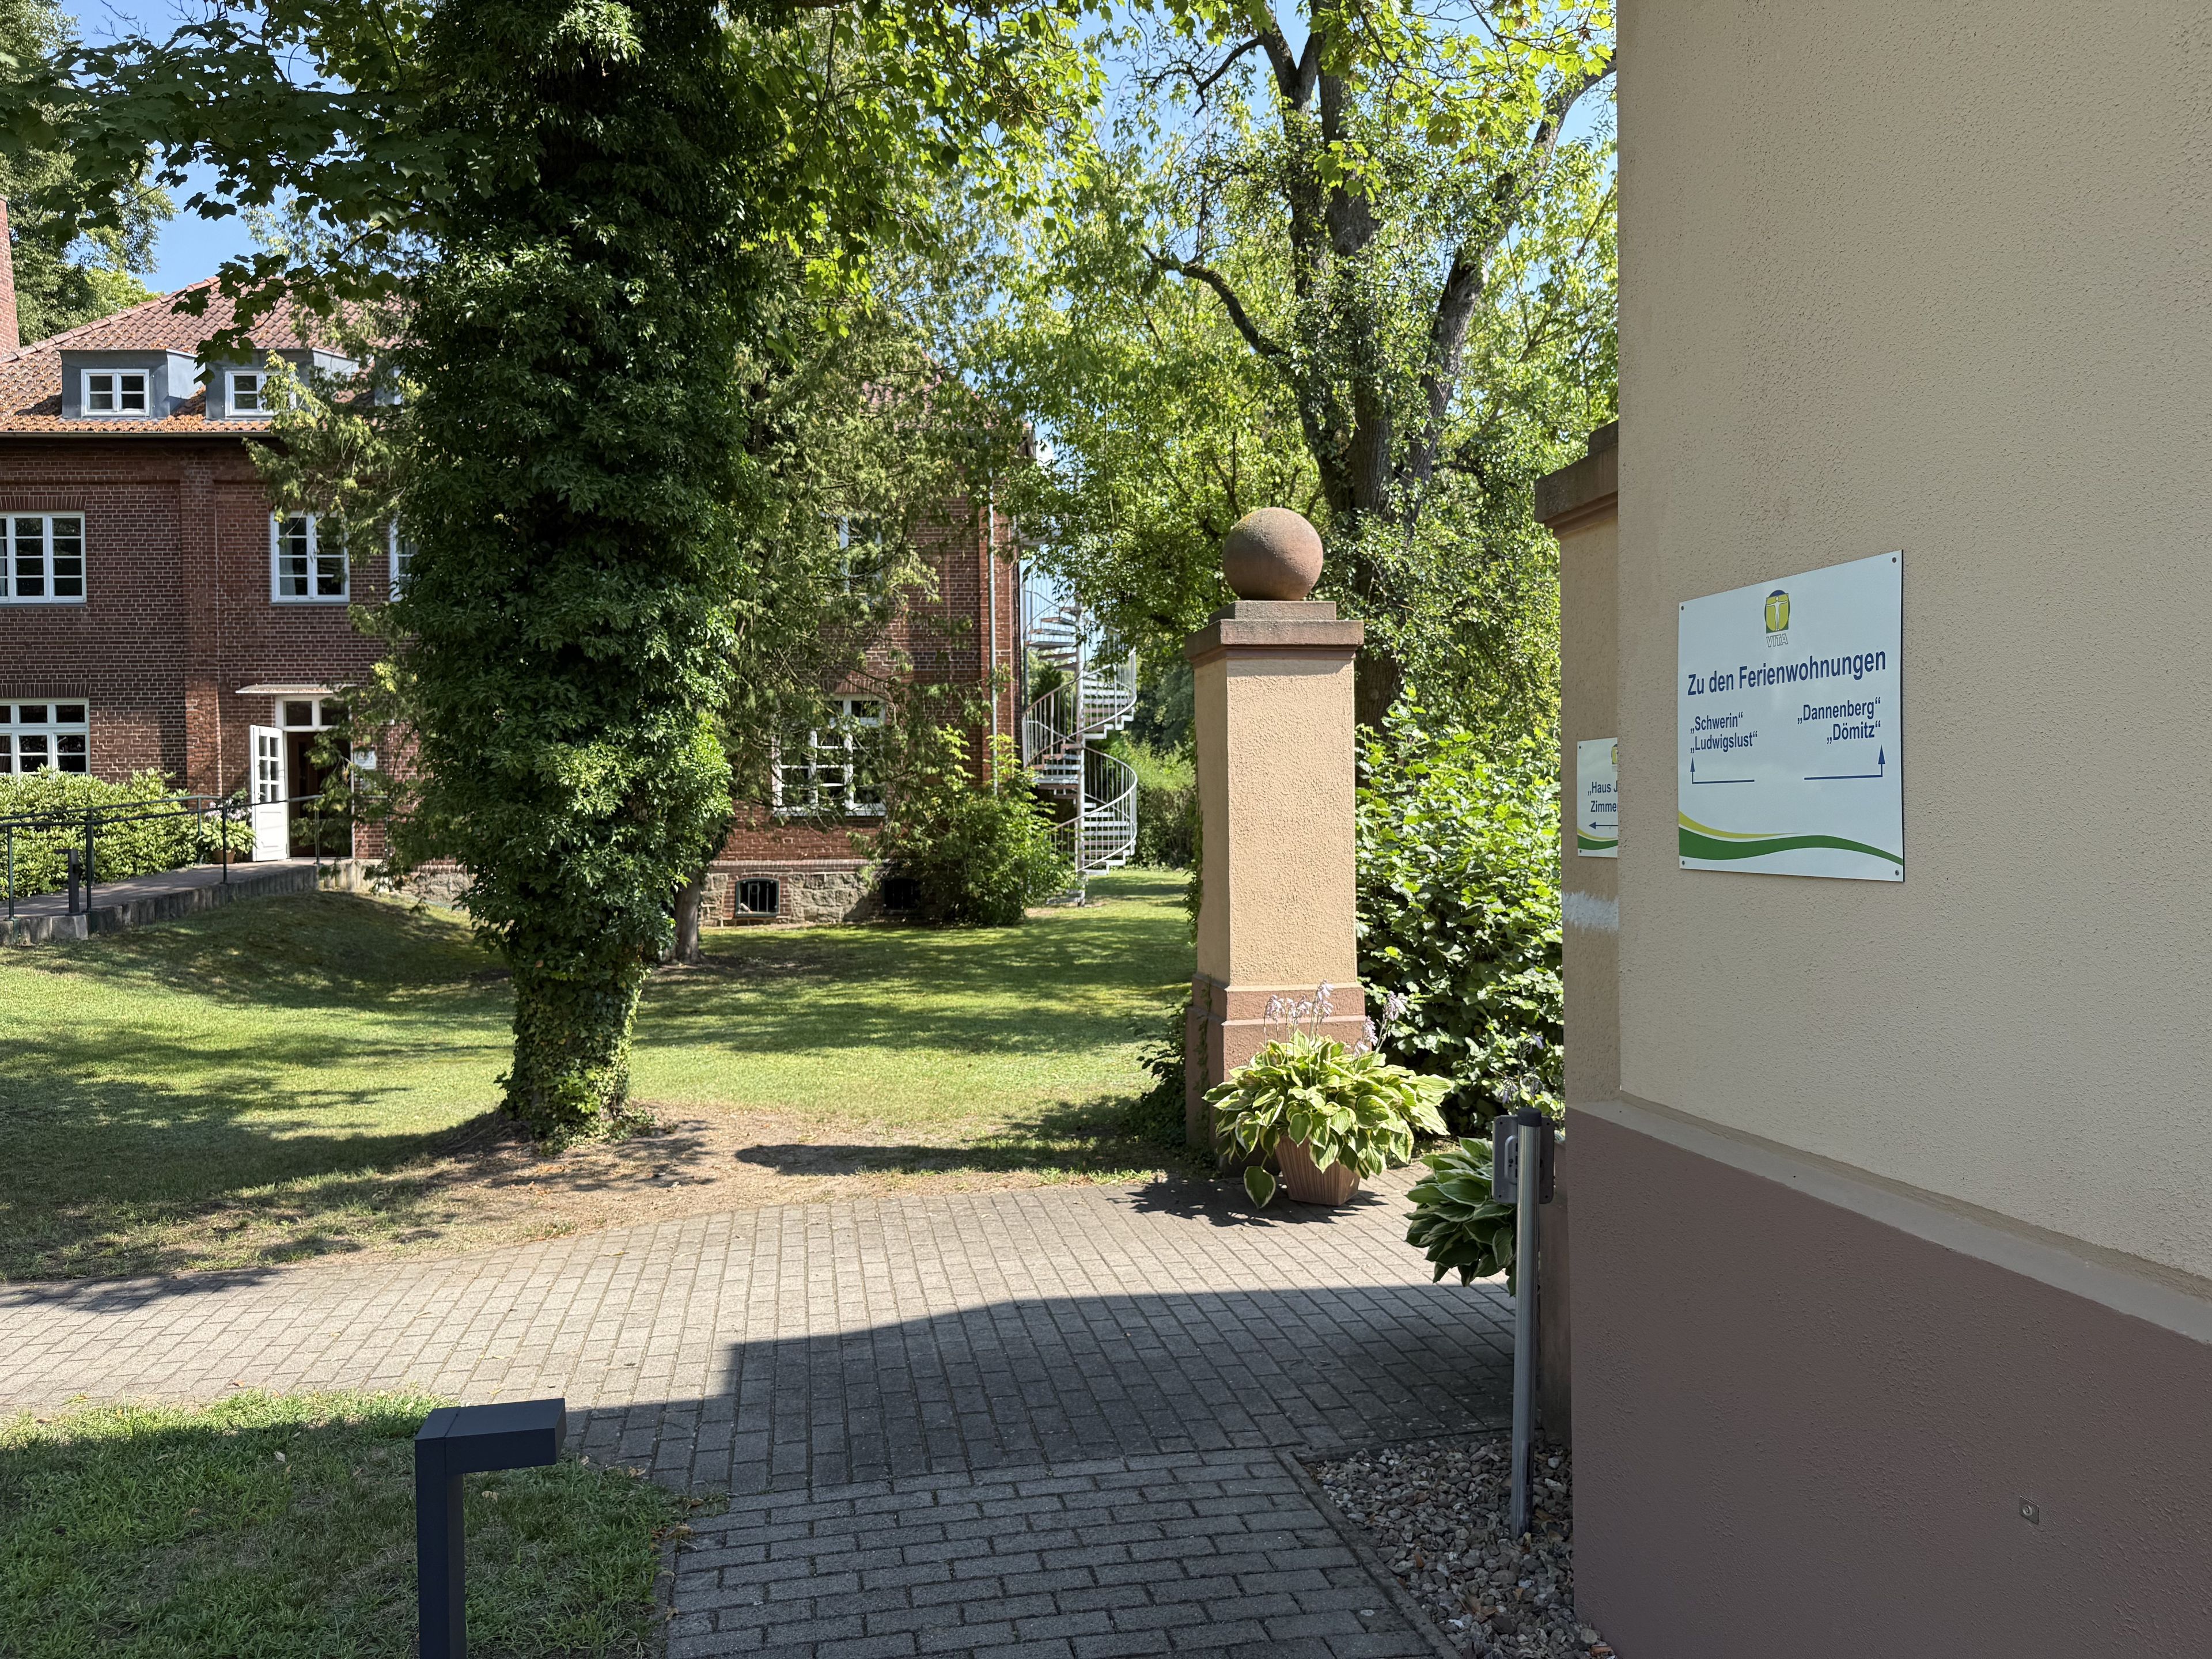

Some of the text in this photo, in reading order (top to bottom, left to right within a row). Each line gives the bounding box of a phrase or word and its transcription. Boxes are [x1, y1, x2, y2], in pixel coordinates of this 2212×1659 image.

[1766, 633, 1788, 647] VITA
[1687, 650, 1886, 695] Zu den Ferienwohnungen
[1690, 711, 1743, 734] „Schwerin“
[1797, 696, 1881, 725] „Dannenberg“
[1690, 730, 1758, 754] „Ludwigslust“
[1827, 720, 1881, 745] „Dömitz“
[1590, 800, 1618, 813] Zimme
